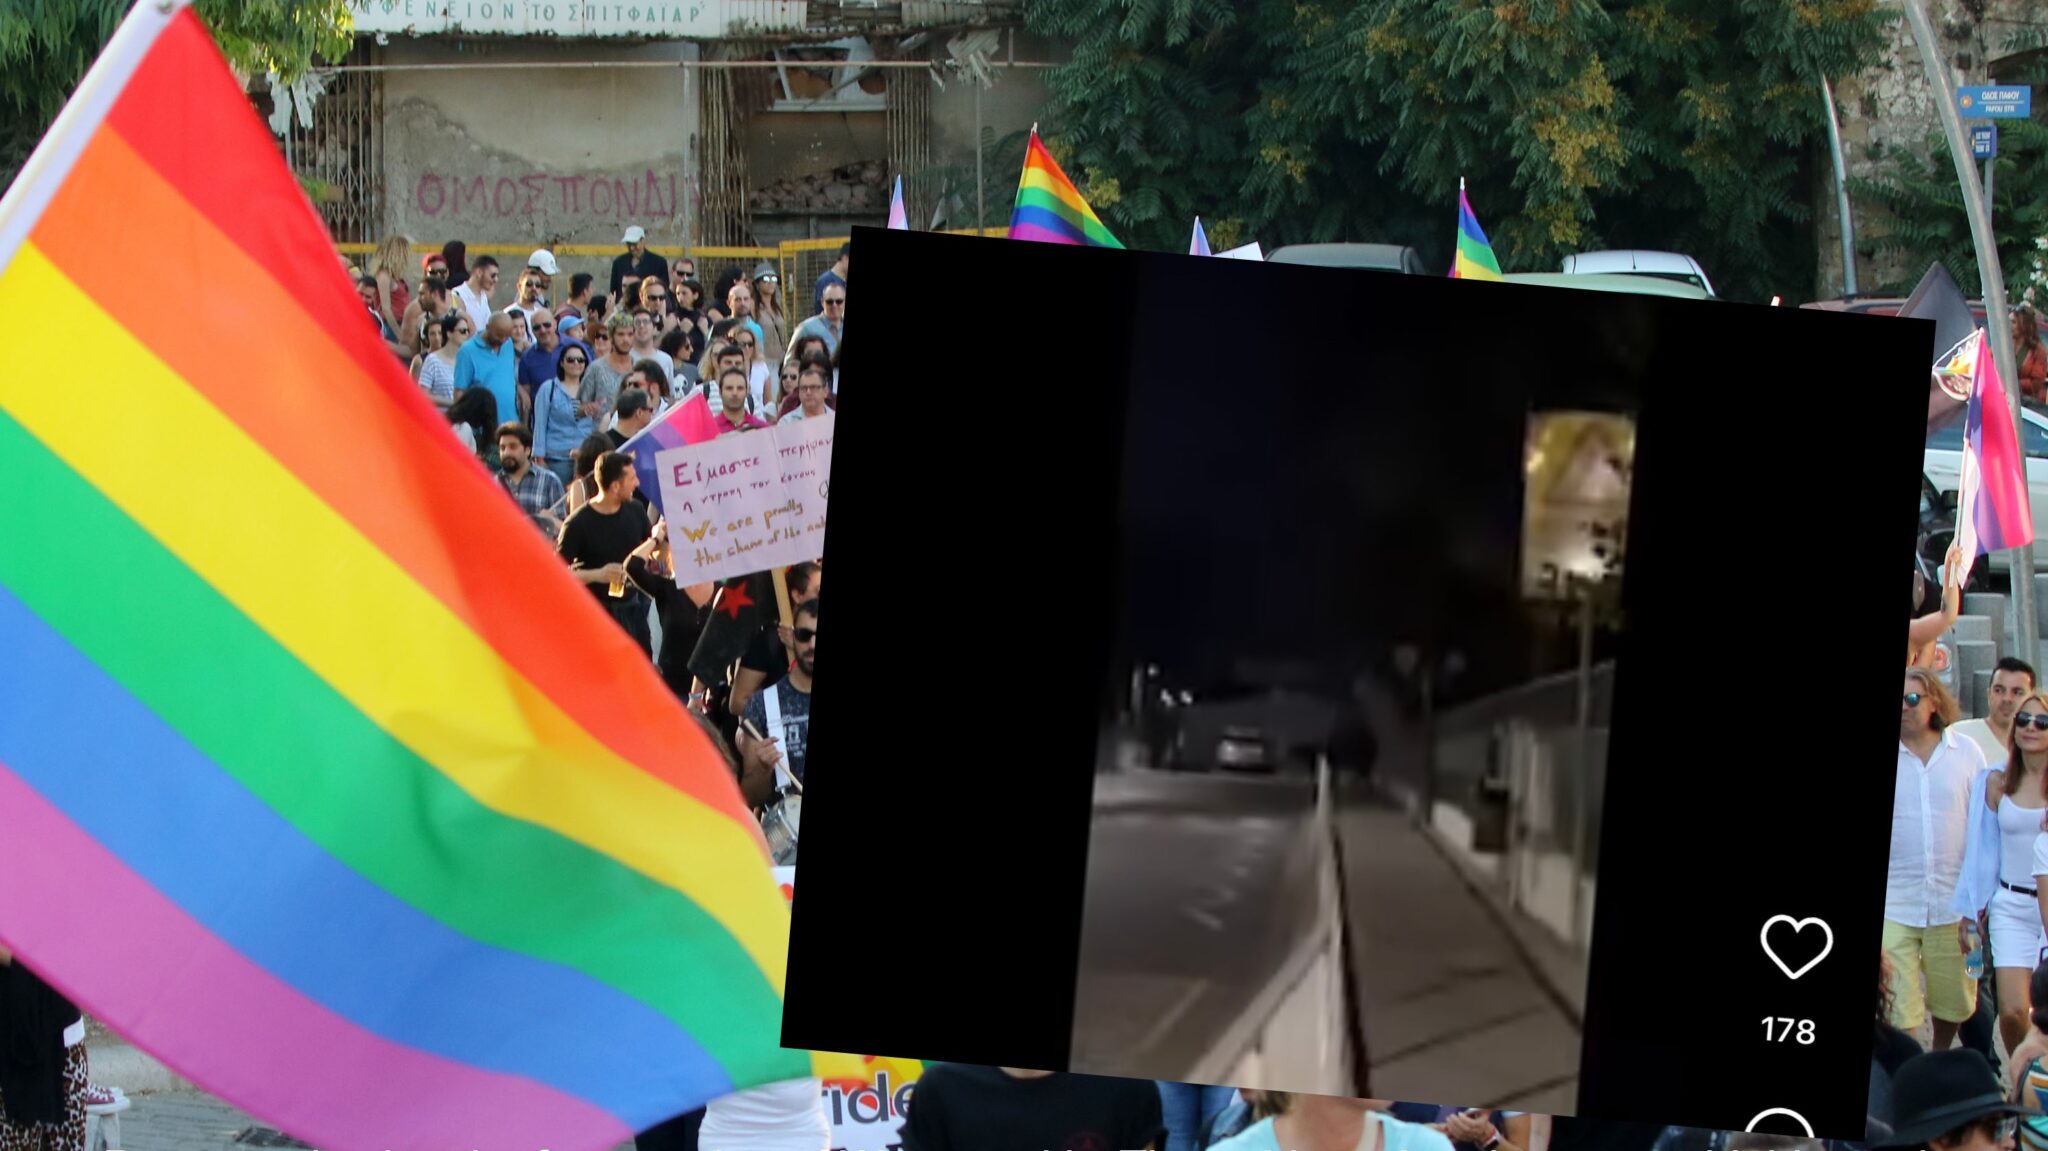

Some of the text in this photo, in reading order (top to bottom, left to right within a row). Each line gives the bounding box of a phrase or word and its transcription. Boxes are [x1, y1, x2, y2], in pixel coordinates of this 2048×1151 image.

[358, 0, 514, 19] ΑΦΕΝΕΙΟΝ
[673, 437, 833, 491] Είμαστε περήφαν
[680, 519, 718, 544] We
[727, 516, 753, 533] are
